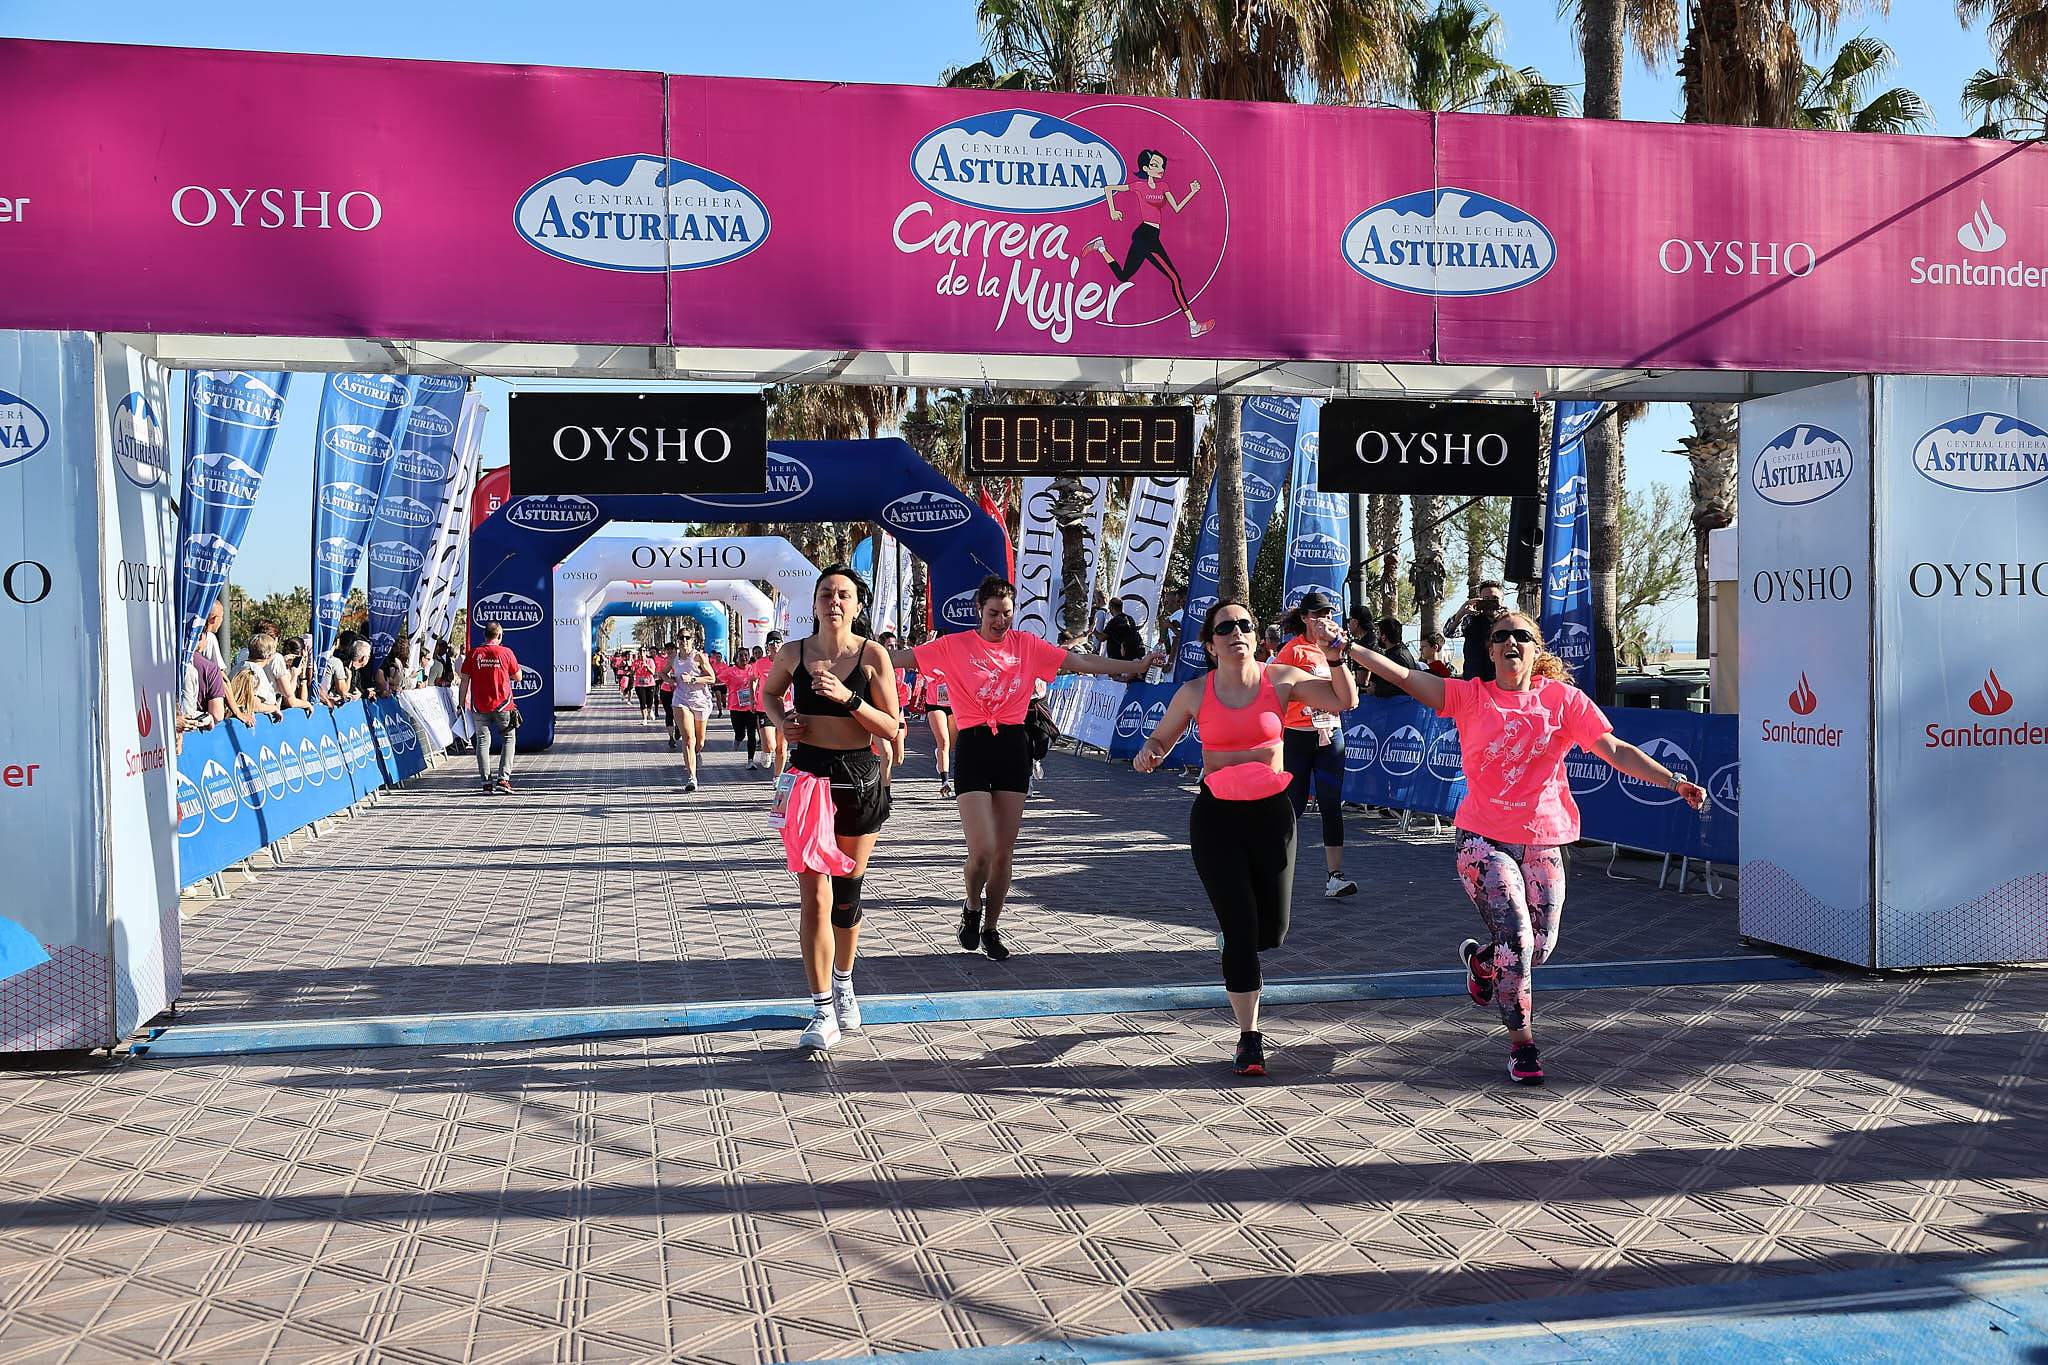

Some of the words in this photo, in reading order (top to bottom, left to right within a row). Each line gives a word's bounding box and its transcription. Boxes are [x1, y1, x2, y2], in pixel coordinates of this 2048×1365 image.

[928, 143, 1109, 190] ASTURIANA
[961, 142, 1029, 157] CENTRAL
[1035, 146, 1104, 159] LECHERA
[171, 185, 383, 231] OYSHO
[574, 193, 655, 207] CENTRAL
[534, 194, 752, 243] ASTURIANA
[892, 201, 1071, 260] Carrera
[1392, 223, 1459, 236] CENTRAL
[1465, 226, 1534, 238] LECHERA
[1358, 224, 1541, 269] ASTURIANA
[1658, 238, 1817, 278] OYSHO
[936, 259, 970, 297] de
[976, 259, 1001, 298] la
[994, 256, 1137, 344] Mujer
[338, 375, 405, 405] ASTURIANA
[117, 428, 162, 469] ASTURIANA
[552, 424, 733, 463] OYSHO
[981, 416, 1178, 464] 00:42:22
[1355, 429, 1510, 467] OYSHO
[1946, 440, 1994, 448] CENTRAL
[1998, 440, 2047, 449] LECHERA
[1923, 441, 2048, 473] ASTURIANA
[1758, 457, 1846, 490] ASTURIANA
[511, 504, 592, 523] ASTURIANA
[889, 507, 966, 523] ASTURIANA
[630, 545, 747, 570] OYSHO
[778, 569, 813, 578] OYSHO
[117, 559, 167, 605] OYSHO
[562, 571, 599, 581] OYSHO
[1753, 564, 1852, 604] OYSHO
[475, 606, 539, 622] ASTURIANA
[1761, 719, 1843, 748] Santander
[125, 747, 166, 777] Santander
[1382, 743, 1421, 764] ASTURIANA
